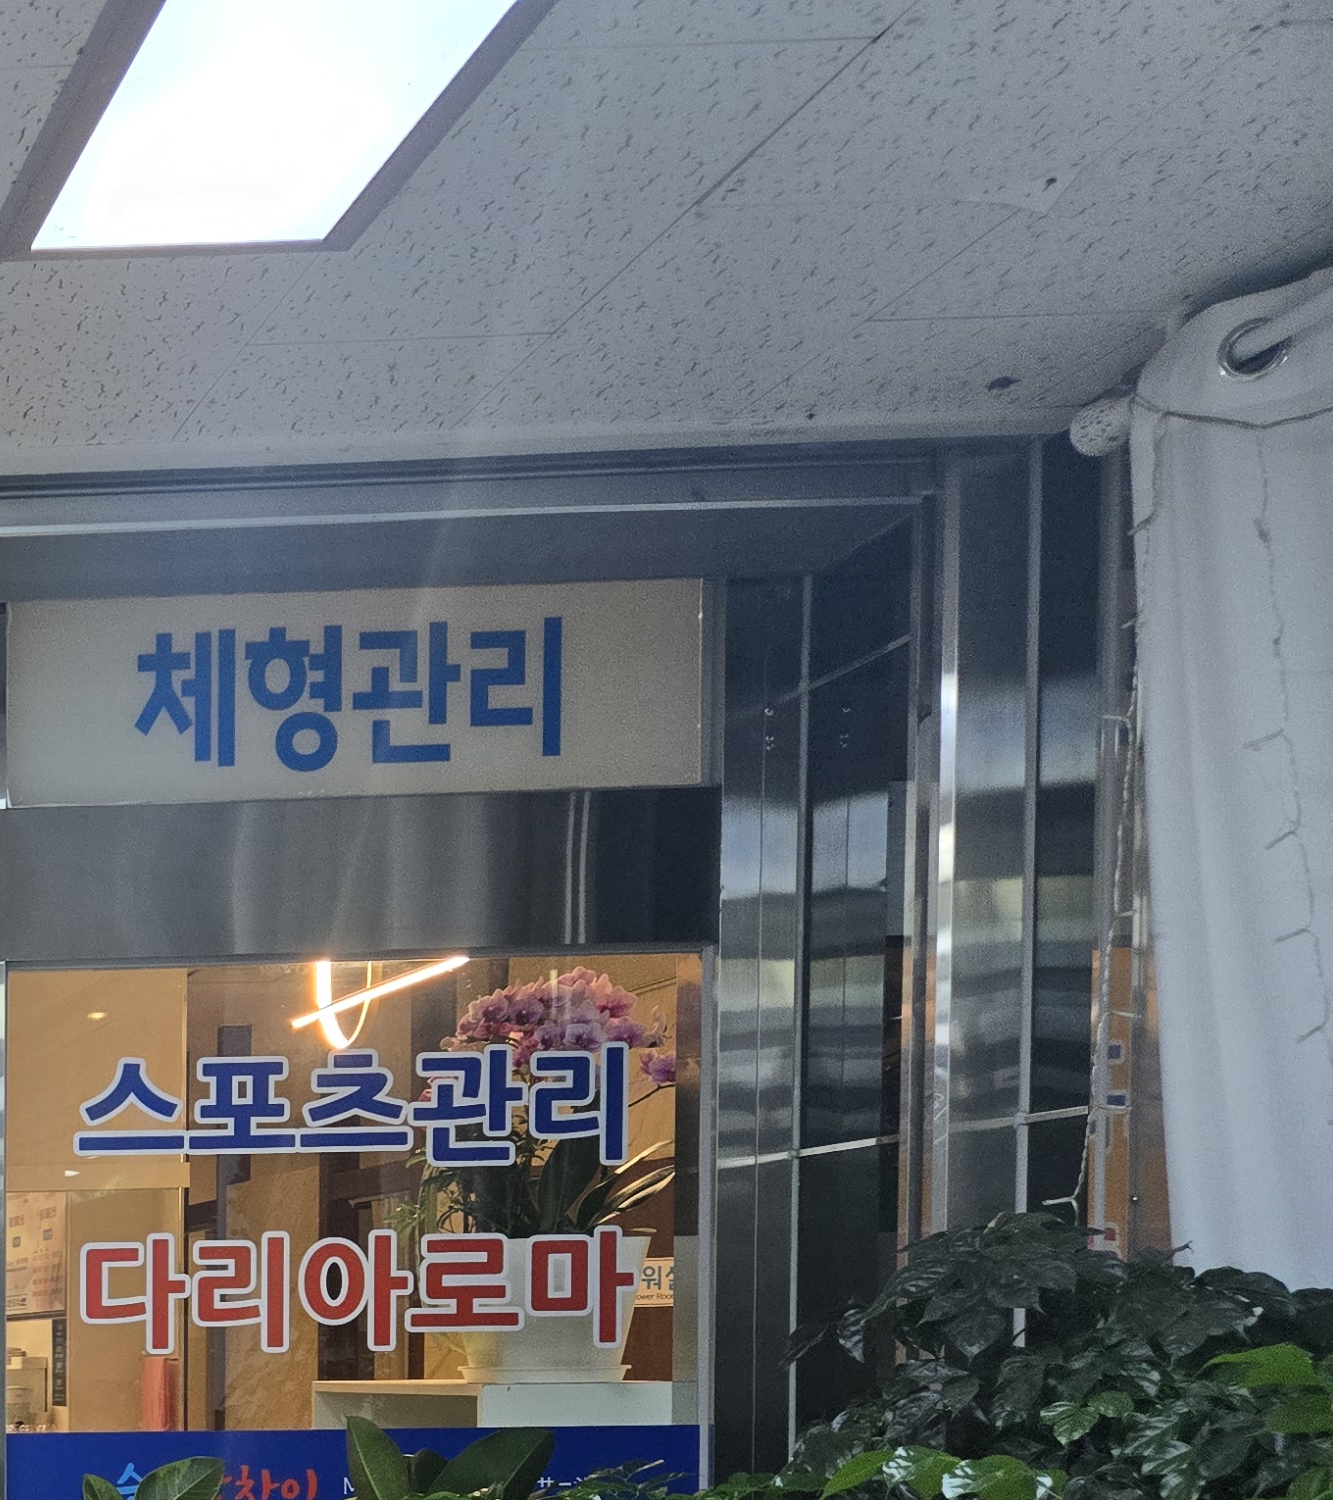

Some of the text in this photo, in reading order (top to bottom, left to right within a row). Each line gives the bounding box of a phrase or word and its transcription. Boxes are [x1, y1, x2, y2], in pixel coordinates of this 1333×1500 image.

[134, 616, 562, 772] 체형관리
[73, 1041, 630, 1167] 스포츠관리
[79, 1224, 636, 1355] 다리아로마
